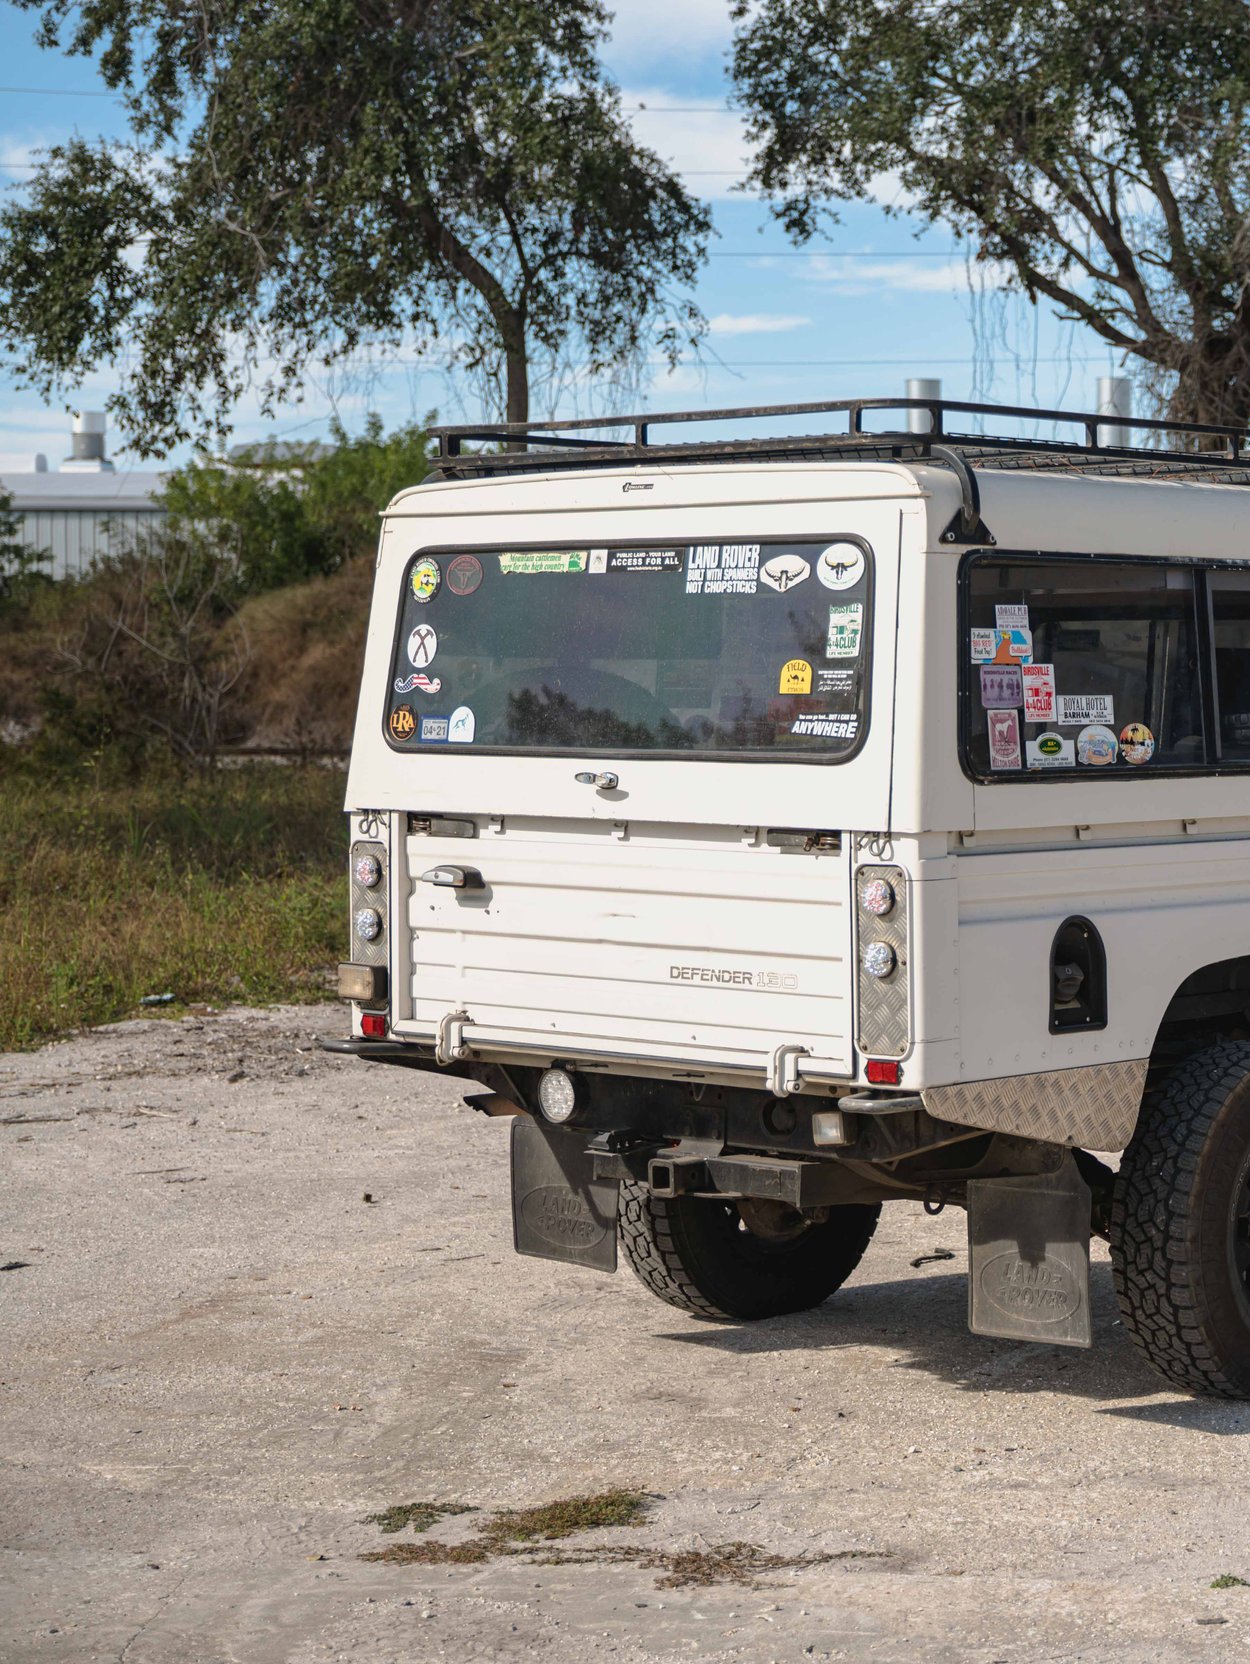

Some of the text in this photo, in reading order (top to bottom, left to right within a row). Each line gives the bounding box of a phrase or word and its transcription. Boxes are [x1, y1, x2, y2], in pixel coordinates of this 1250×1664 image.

[611, 556, 680, 566] ACCESS FOR ALL
[688, 544, 760, 569] LAND ROVER
[531, 562, 544, 571] high
[544, 562, 565, 570] country
[687, 567, 758, 581] BUILT WITH SPANNERS
[686, 580, 757, 594] NOT CHOPSTICKS
[829, 603, 860, 615] BIRDSVILLE
[787, 661, 807, 673] FIELD
[1023, 666, 1050, 676] BIRDSVILLE
[1063, 697, 1108, 711] ROYAL HOTEL
[392, 710, 415, 732] LRA
[791, 720, 858, 738] ANYWHERE
[670, 966, 798, 990] DEFENDER 130
[542, 1190, 583, 1217] LAND
[545, 1214, 596, 1239] ROVER
[1002, 1260, 1052, 1287] LAND
[1006, 1283, 1069, 1309] ROVER
